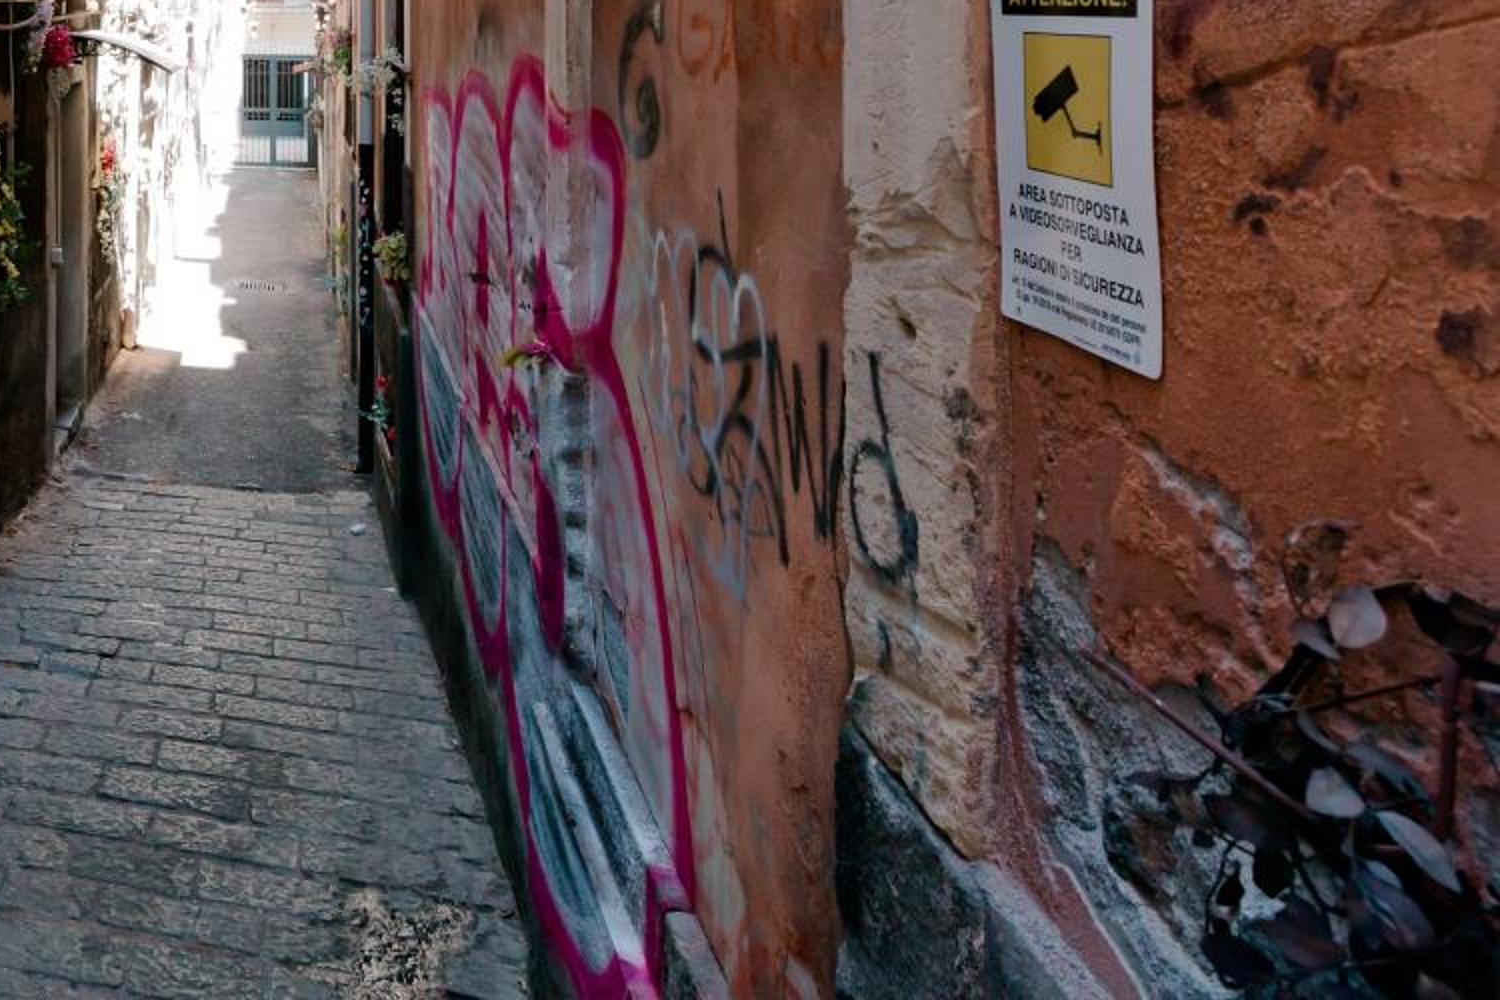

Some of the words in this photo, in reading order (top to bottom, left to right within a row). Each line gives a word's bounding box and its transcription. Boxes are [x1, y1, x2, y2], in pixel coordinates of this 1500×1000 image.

[1019, 183, 1047, 205] AREA
[1049, 189, 1130, 226] SOTTOPOSTA
[1009, 203, 1017, 218] A
[1019, 205, 1145, 257] VIDEOSORVEGLIANZA
[1061, 240, 1083, 263] PER
[1013, 247, 1058, 277] RAGIONI
[1059, 263, 1071, 282] DI
[1072, 268, 1145, 309] SICUREZZA
